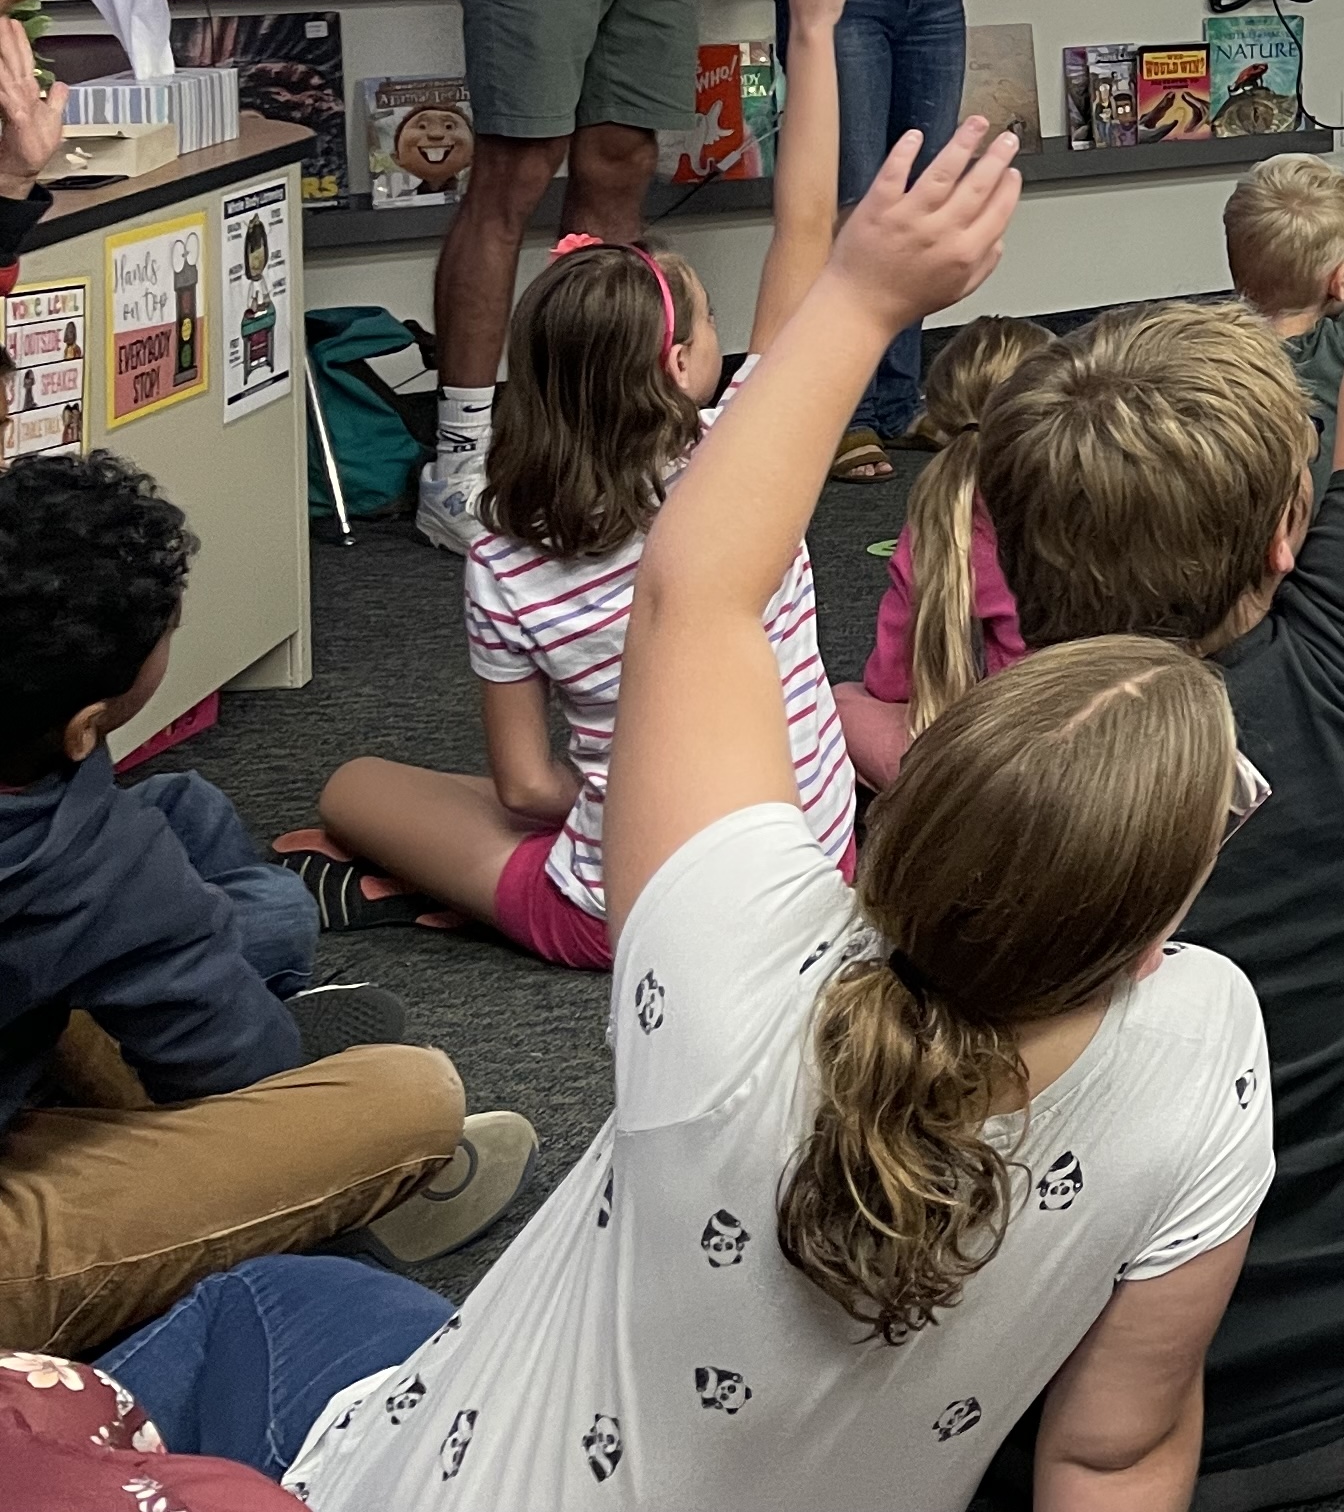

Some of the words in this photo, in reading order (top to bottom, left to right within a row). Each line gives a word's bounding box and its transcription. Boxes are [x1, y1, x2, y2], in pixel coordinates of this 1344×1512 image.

[1145, 60, 1179, 78] WOULD
[1180, 57, 1205, 75] WIN?
[1216, 41, 1298, 63] NATURE
[114, 251, 162, 294] Hands
[24, 328, 62, 356] OUTSIDE
[119, 329, 172, 376] EVERYBODY
[133, 366, 161, 404] STOP!
